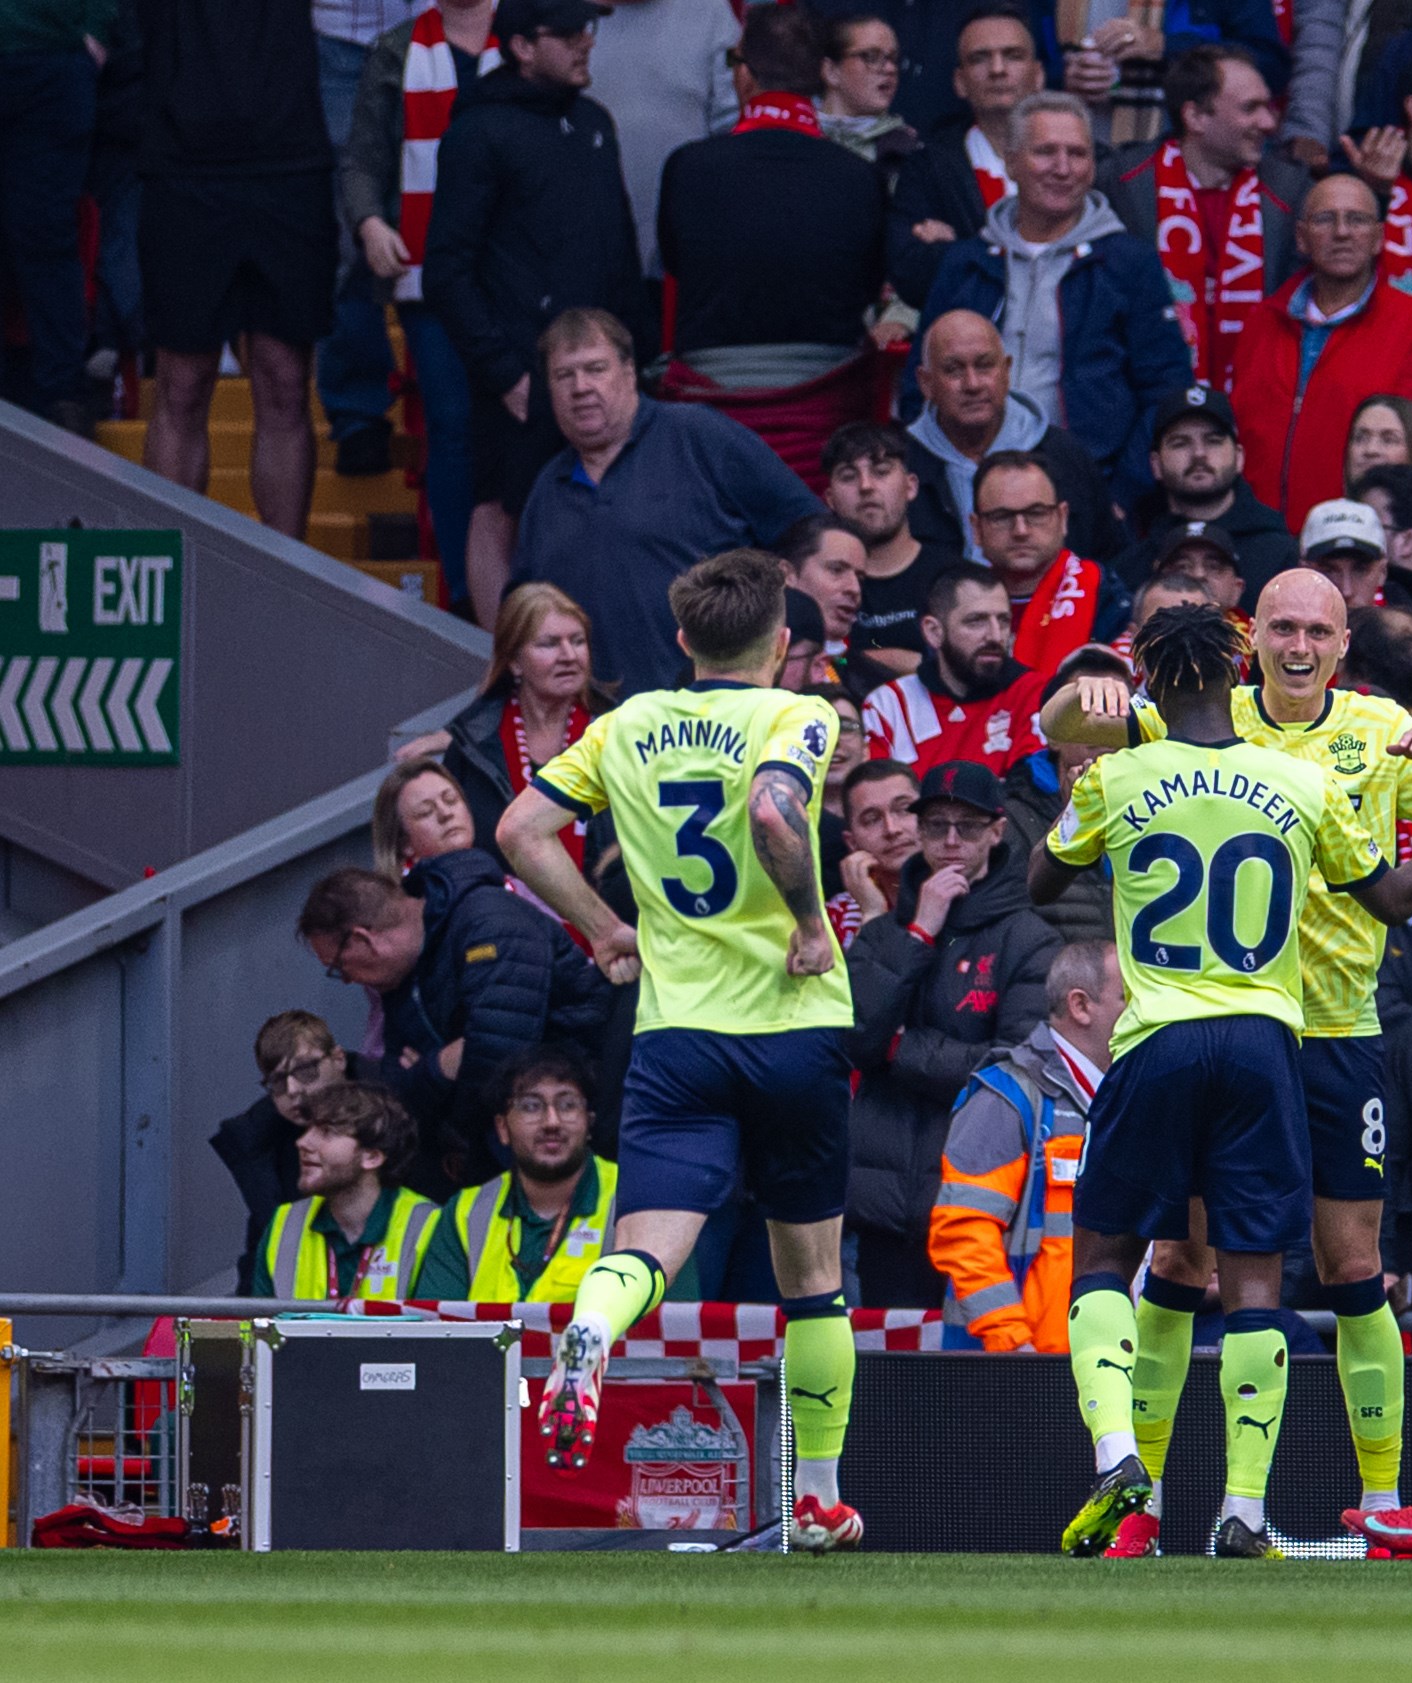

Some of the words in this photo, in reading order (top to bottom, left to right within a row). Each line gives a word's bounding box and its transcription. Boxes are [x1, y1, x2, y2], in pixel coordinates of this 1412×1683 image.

[94, 555, 174, 625] EXIT
[1122, 769, 1300, 836] KAMALDEEN
[658, 780, 739, 919] 3
[1128, 832, 1294, 974] 20
[1361, 1097, 1386, 1155] 8
[1360, 1406, 1384, 1418] SFC
[641, 1478, 720, 1495] LIVERPOOL
